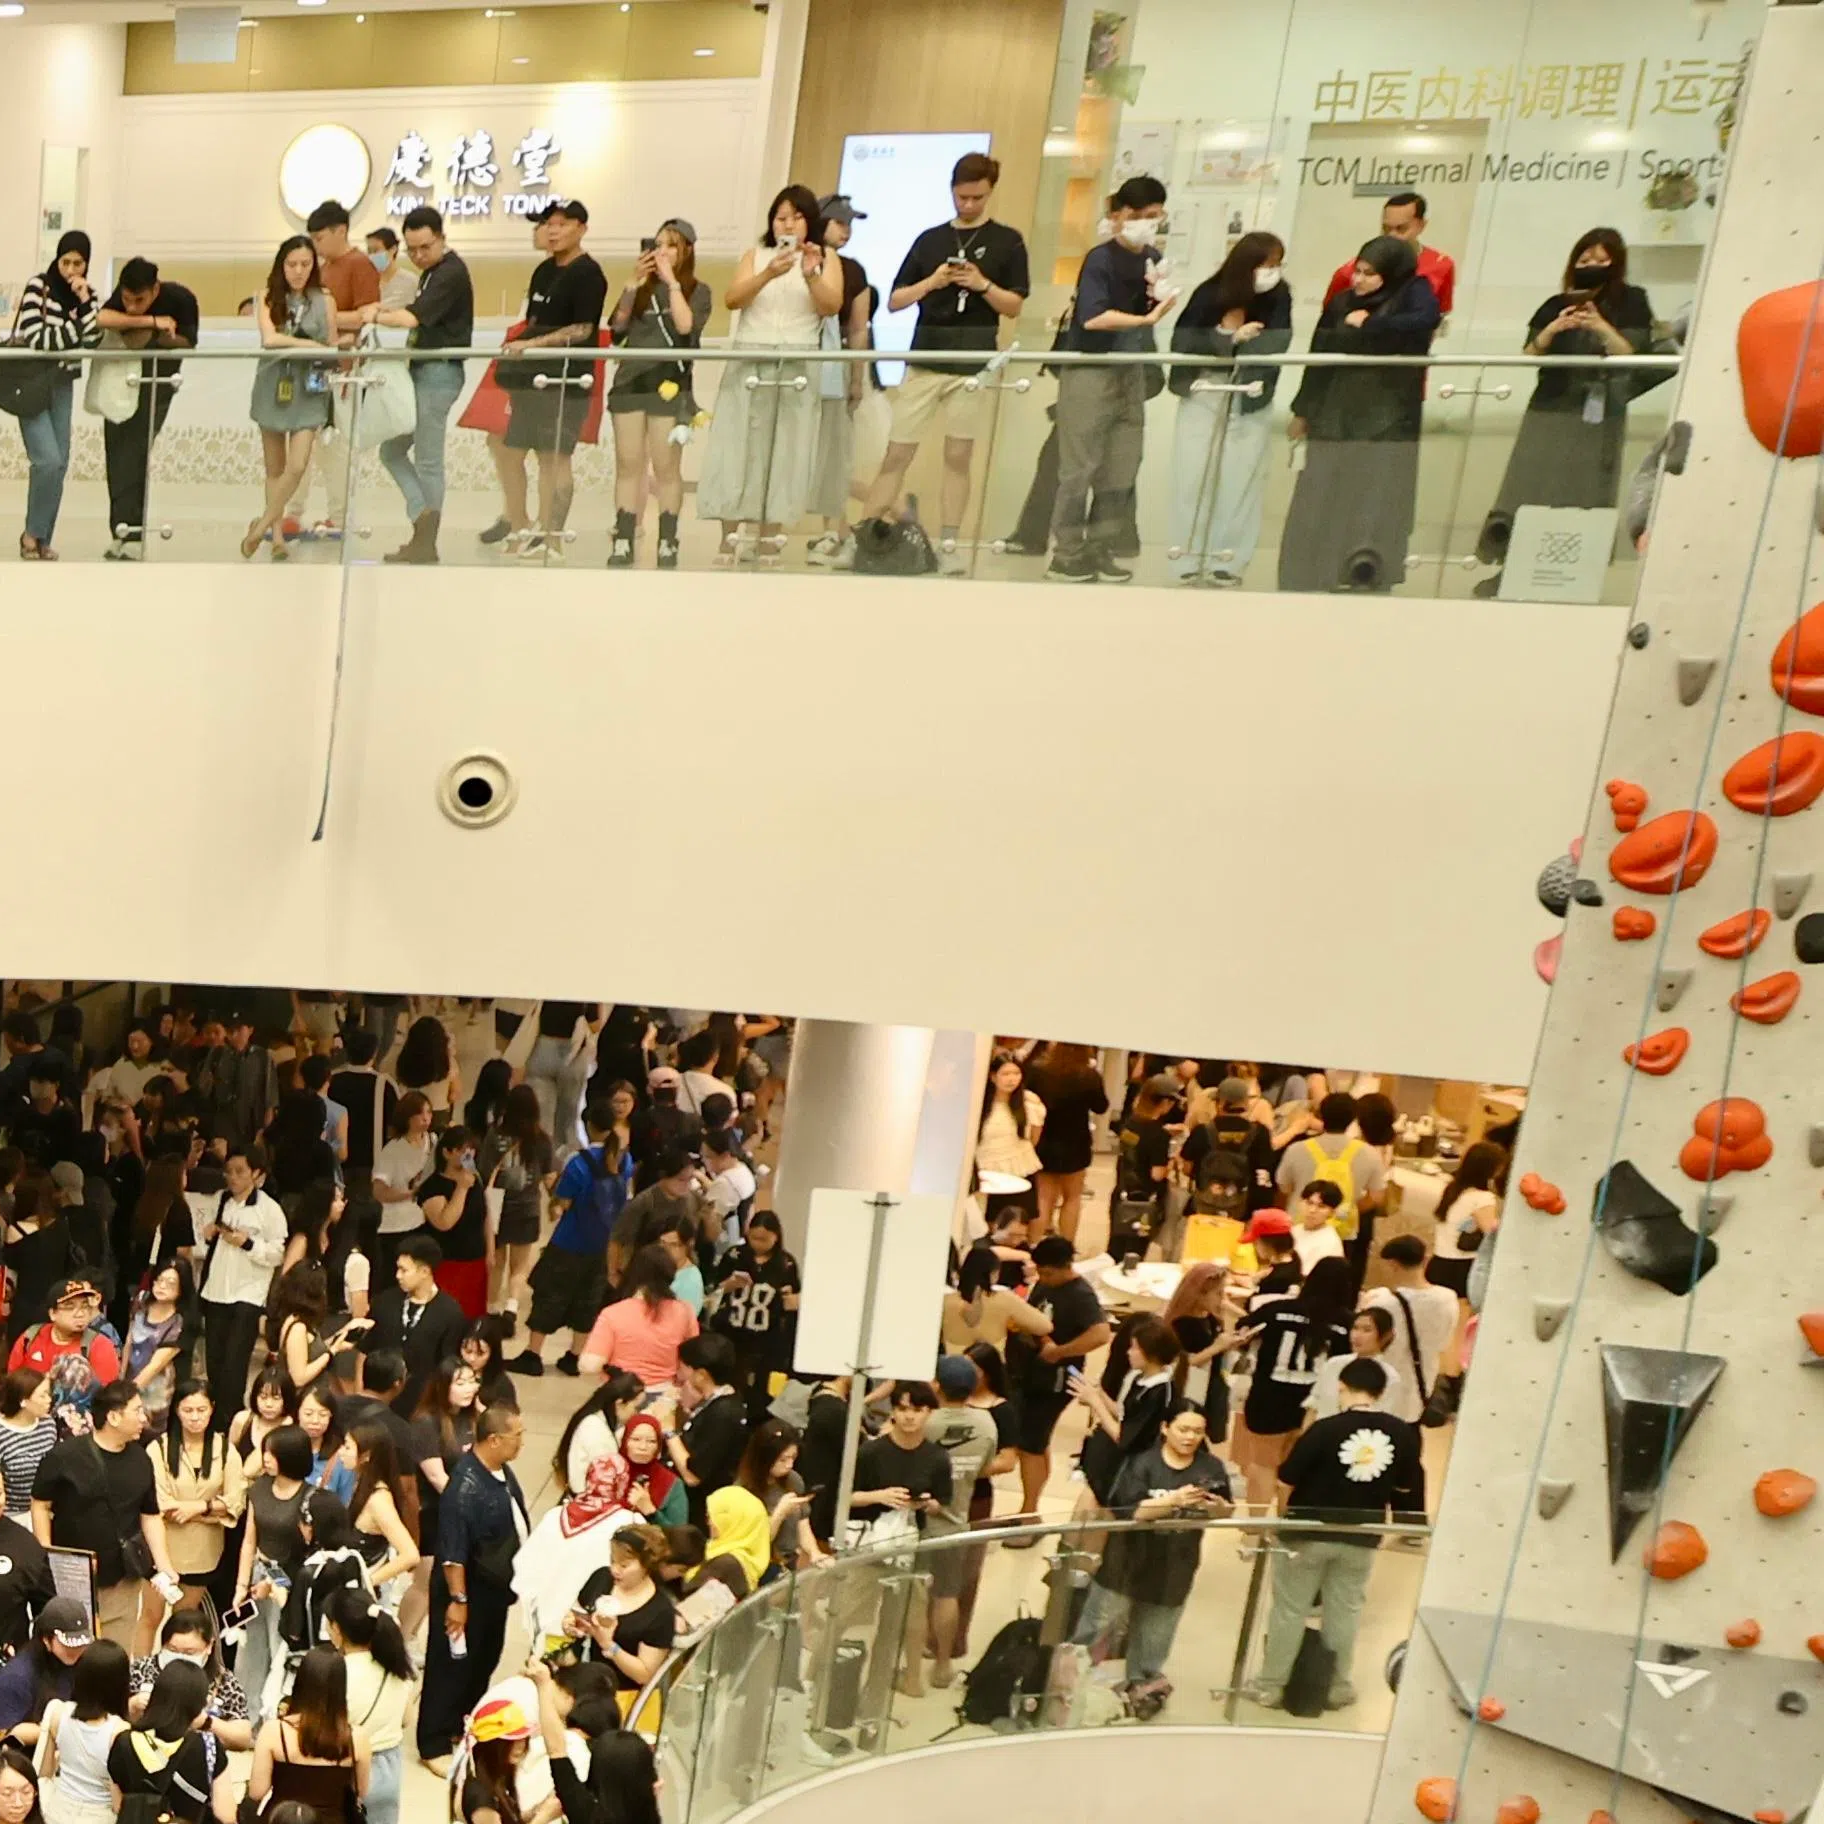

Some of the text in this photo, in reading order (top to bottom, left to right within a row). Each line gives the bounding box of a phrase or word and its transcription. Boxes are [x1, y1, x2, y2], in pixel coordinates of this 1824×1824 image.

[1314, 61, 1626, 126] 中医内科调理
[1298, 156, 1362, 187] TCM
[1368, 151, 1474, 185] Internal
[1480, 149, 1610, 183] Medicine
[439, 196, 490, 216] TECK
